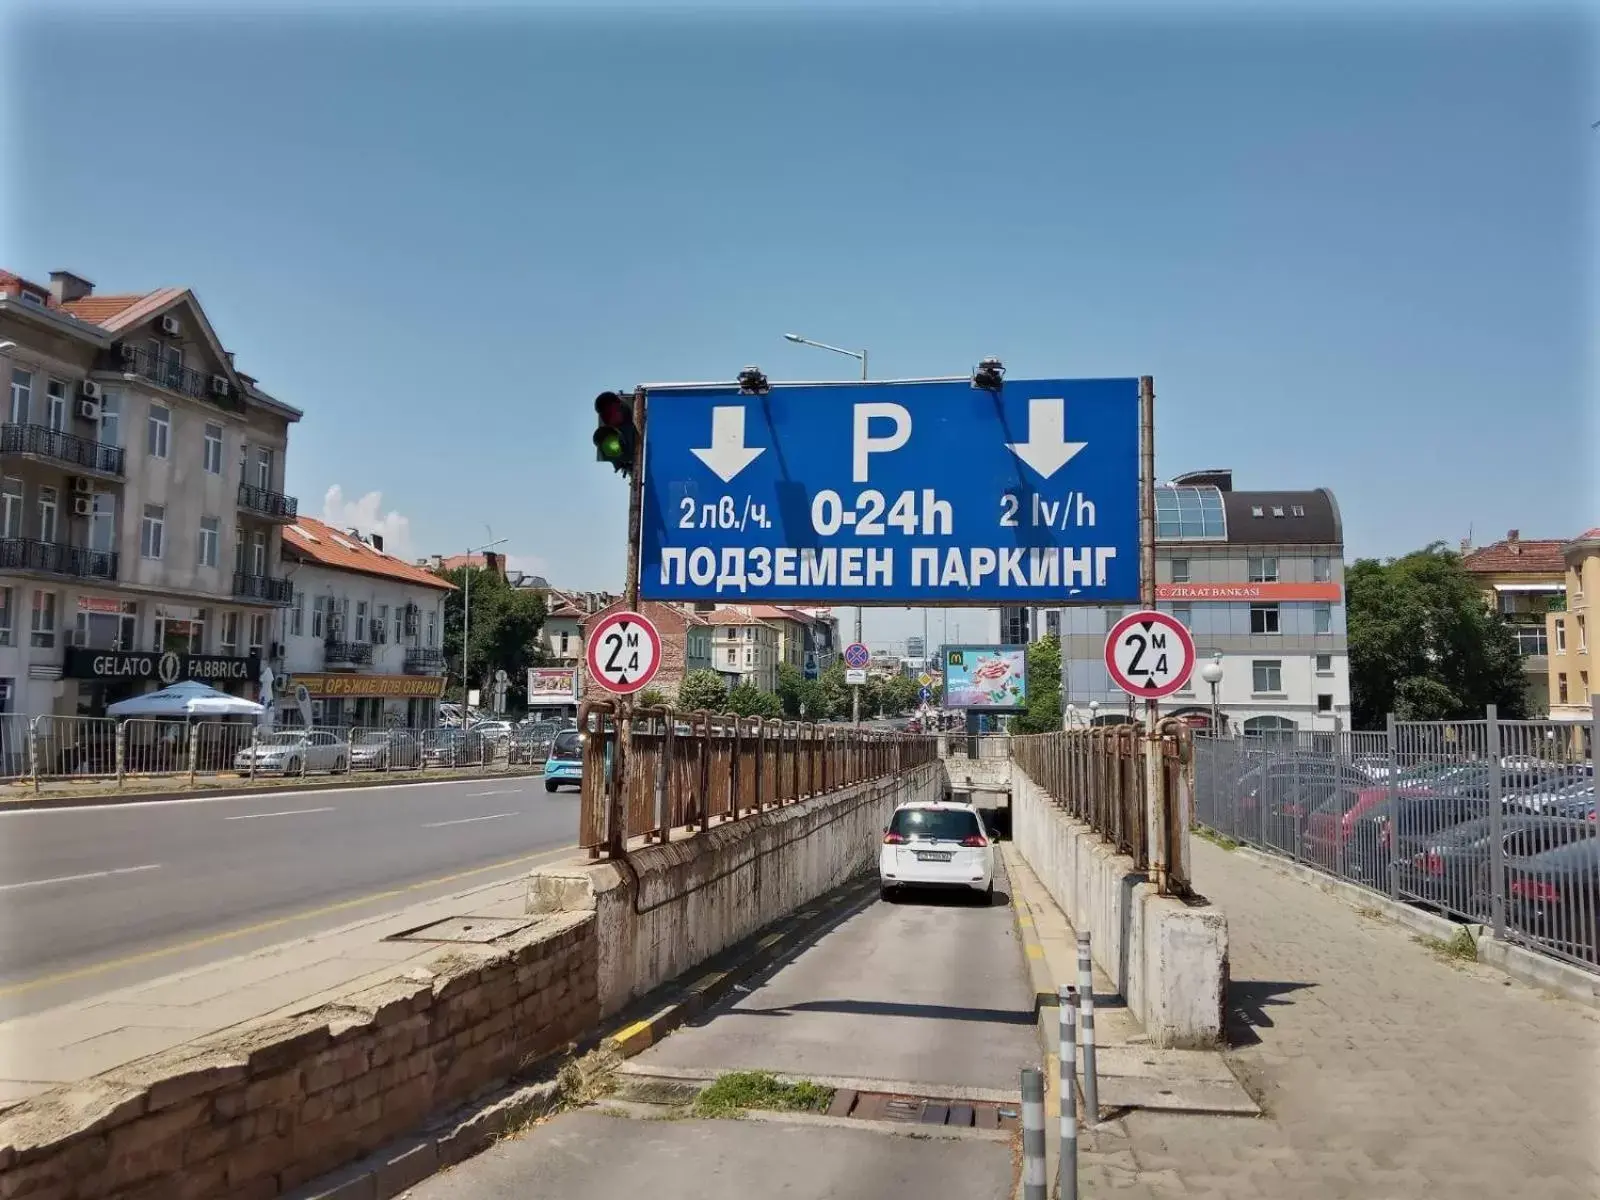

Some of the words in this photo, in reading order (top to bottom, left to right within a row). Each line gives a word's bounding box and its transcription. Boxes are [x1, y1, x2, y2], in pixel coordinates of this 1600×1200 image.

[852, 402, 912, 483] P
[811, 488, 953, 536] 0-24h
[999, 493, 1019, 527] 2
[1032, 491, 1096, 531] lv/h
[660, 546, 894, 593] ПОДЗЕМЕН
[911, 546, 1117, 587] ПАРКИНГ
[93, 655, 151, 676] GELATO
[187, 659, 248, 679] FABBRICA
